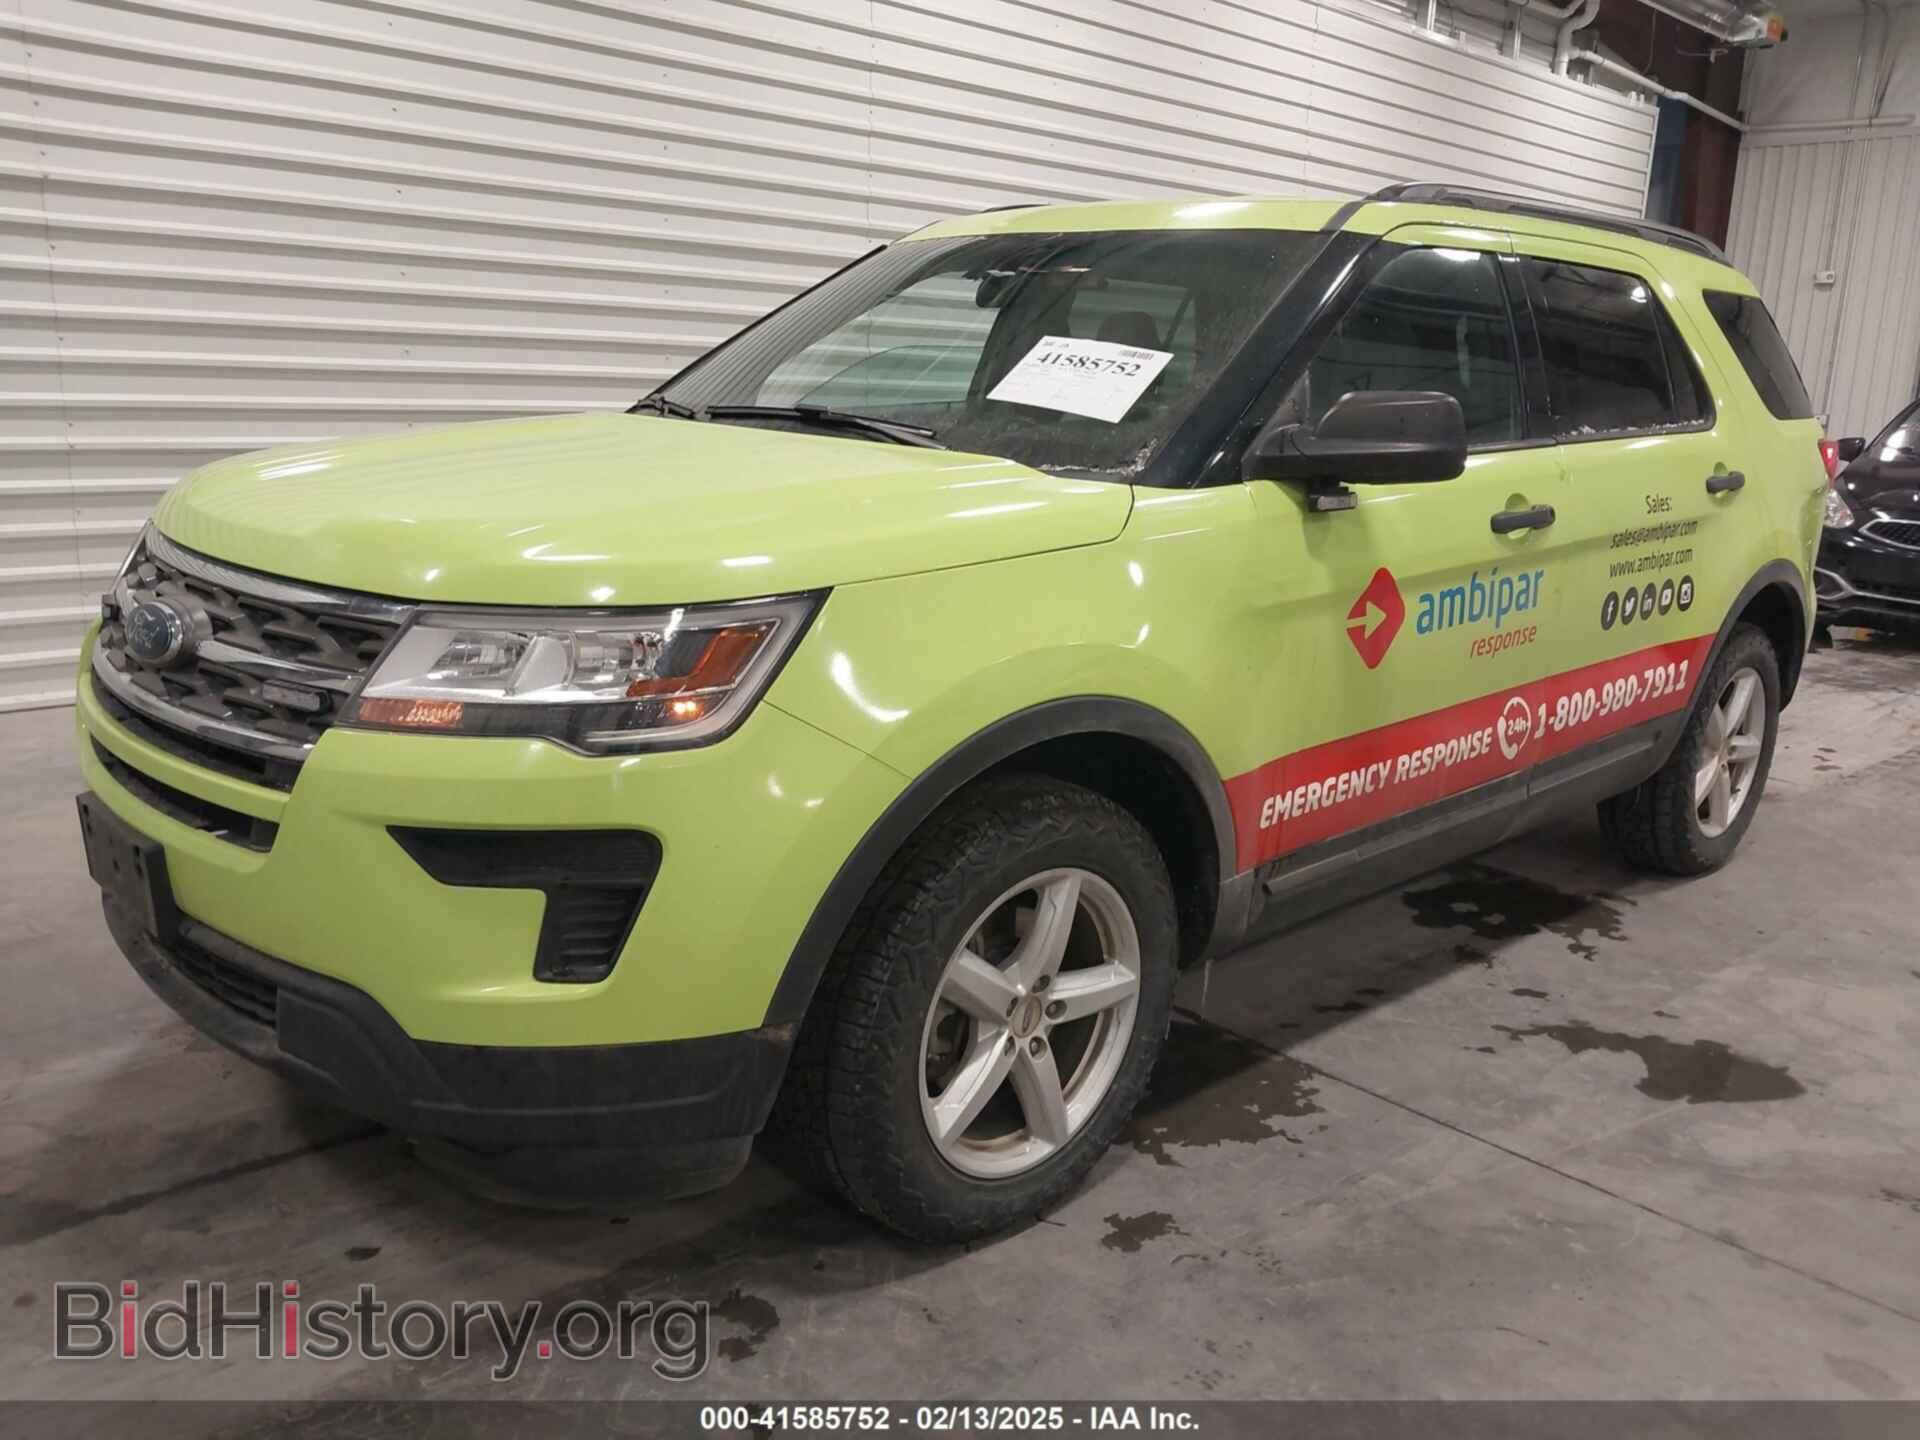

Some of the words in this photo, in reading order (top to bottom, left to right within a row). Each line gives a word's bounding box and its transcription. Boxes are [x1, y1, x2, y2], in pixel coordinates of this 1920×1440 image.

[1037, 351, 1142, 377] 41585752
[1645, 494, 1672, 514] Sales:
[1609, 520, 1698, 549] sales@ambipar.com
[1609, 548, 1693, 578] www.ambipar.com
[1416, 567, 1545, 635] ambipar
[1470, 624, 1537, 659] response
[1259, 759, 1392, 829] EMERGENCY
[1394, 727, 1493, 784] RESPONSE
[1507, 715, 1527, 736] 24h
[1534, 659, 1689, 739] 1-800-980-7911
